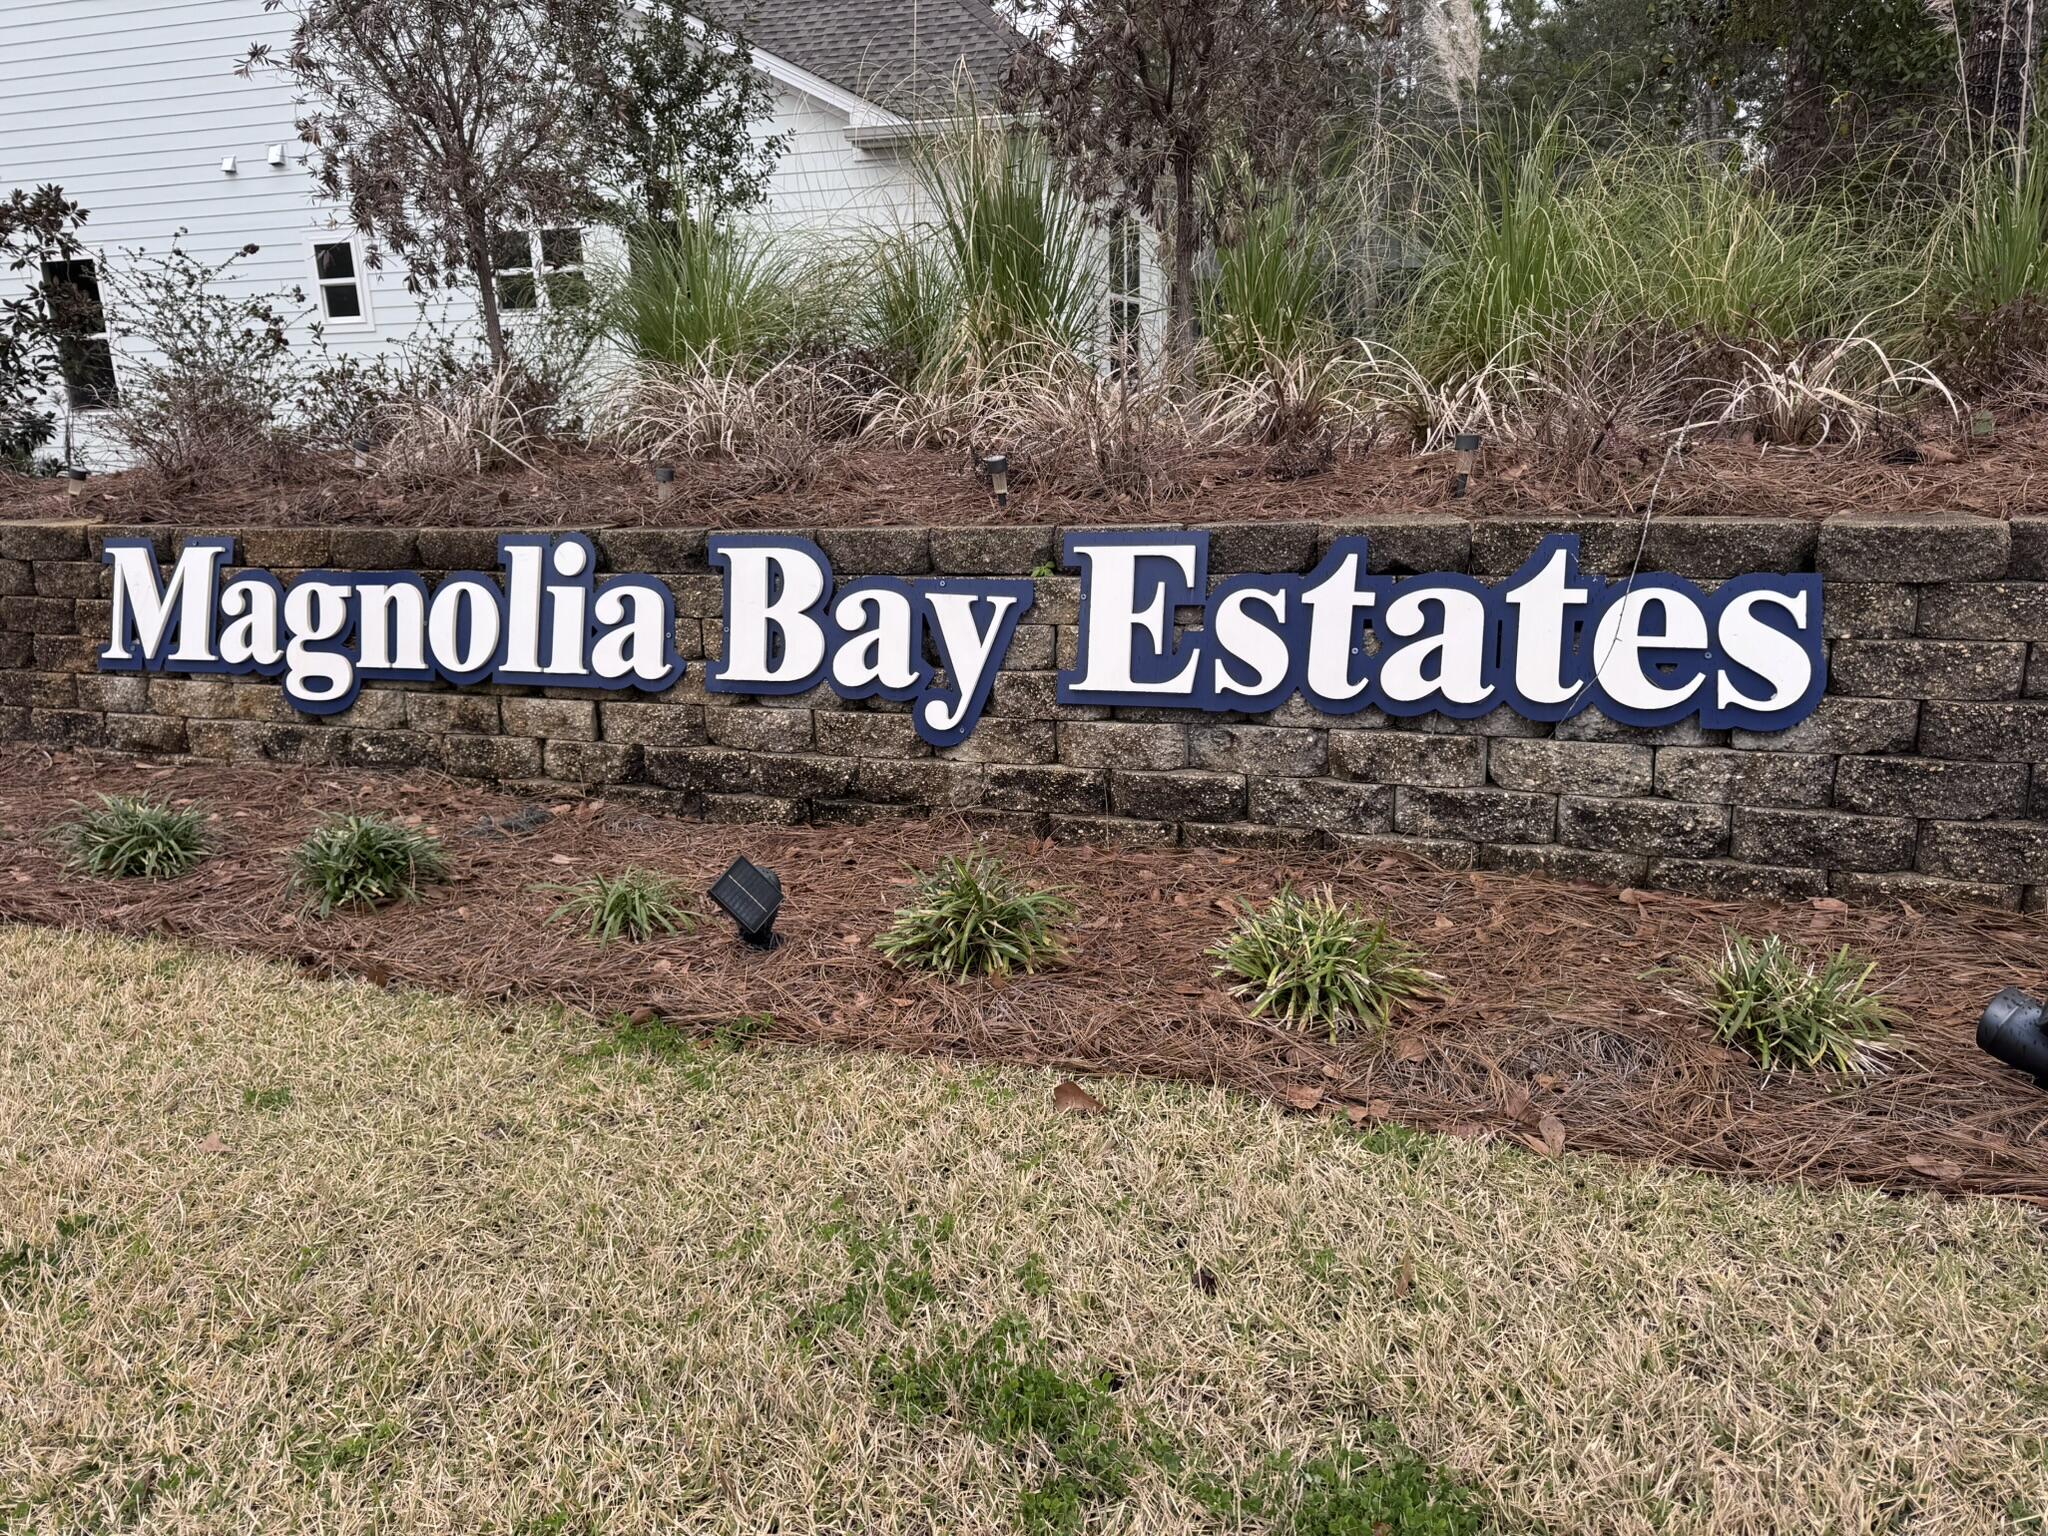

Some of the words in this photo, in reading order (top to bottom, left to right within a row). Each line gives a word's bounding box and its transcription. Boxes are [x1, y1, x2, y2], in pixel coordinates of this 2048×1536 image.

[101, 541, 672, 701] Magnolia
[715, 547, 1017, 731] Bay
[1068, 545, 1812, 712] Estates
